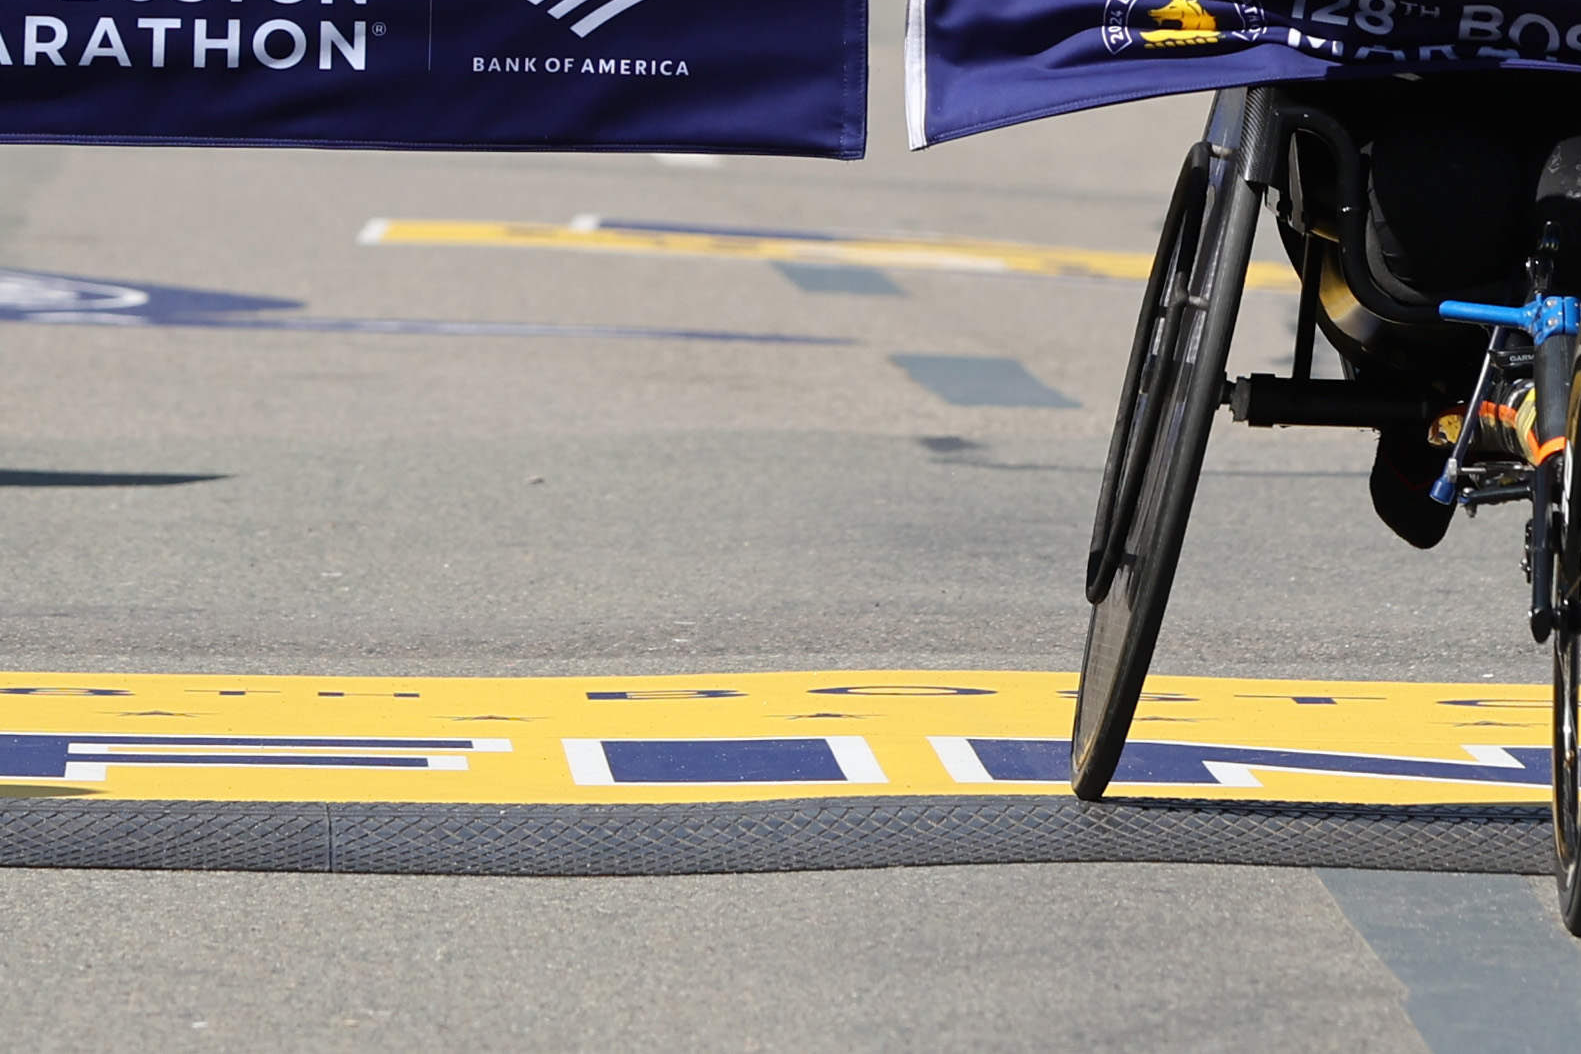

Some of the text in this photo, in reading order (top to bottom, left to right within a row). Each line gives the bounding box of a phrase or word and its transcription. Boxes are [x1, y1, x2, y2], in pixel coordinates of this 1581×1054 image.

[472, 57, 690, 77] BANK OF AMERICA
